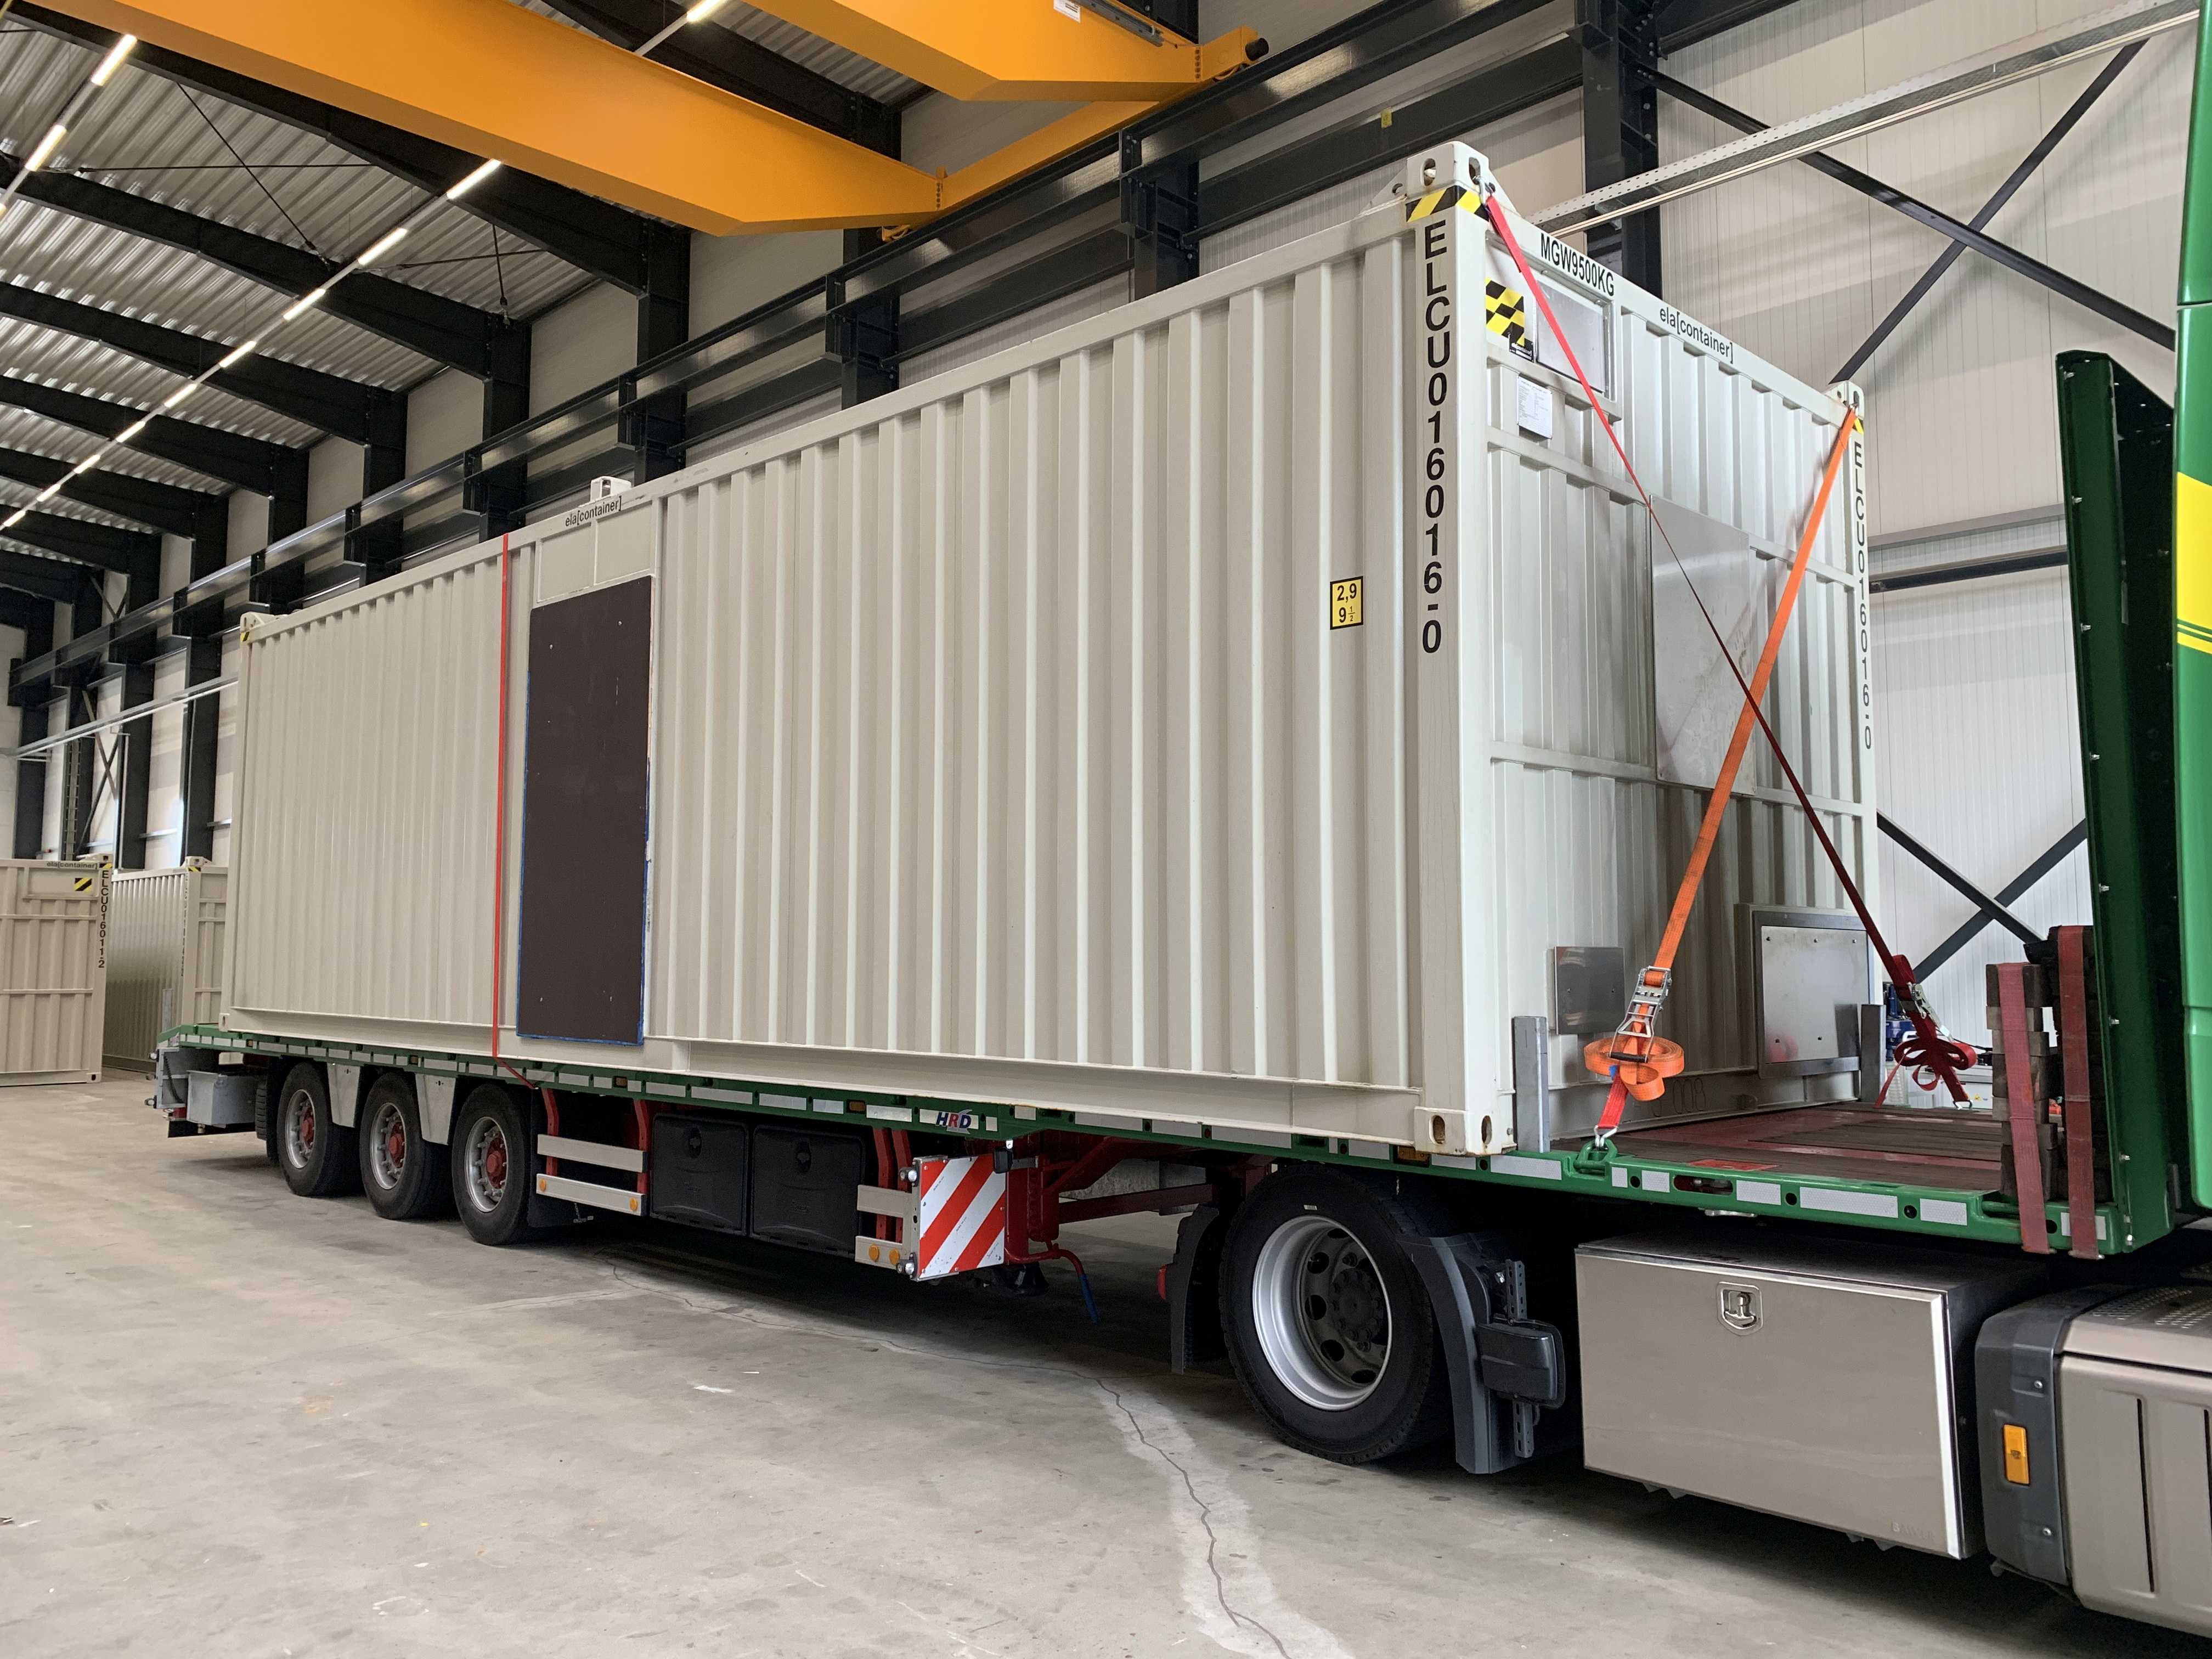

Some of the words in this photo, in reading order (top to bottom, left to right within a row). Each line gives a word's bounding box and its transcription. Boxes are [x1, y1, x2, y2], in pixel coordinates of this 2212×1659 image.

[1541, 234, 1614, 296] MGW9500KG
[1660, 307, 1733, 364] ela[container]
[1423, 219, 1451, 653] ELCU0160016-0
[566, 495, 621, 527] ela[container]
[1337, 583, 1357, 603] 2,9
[47, 861, 98, 870] ela[container]
[936, 1112, 972, 1128] HRD
